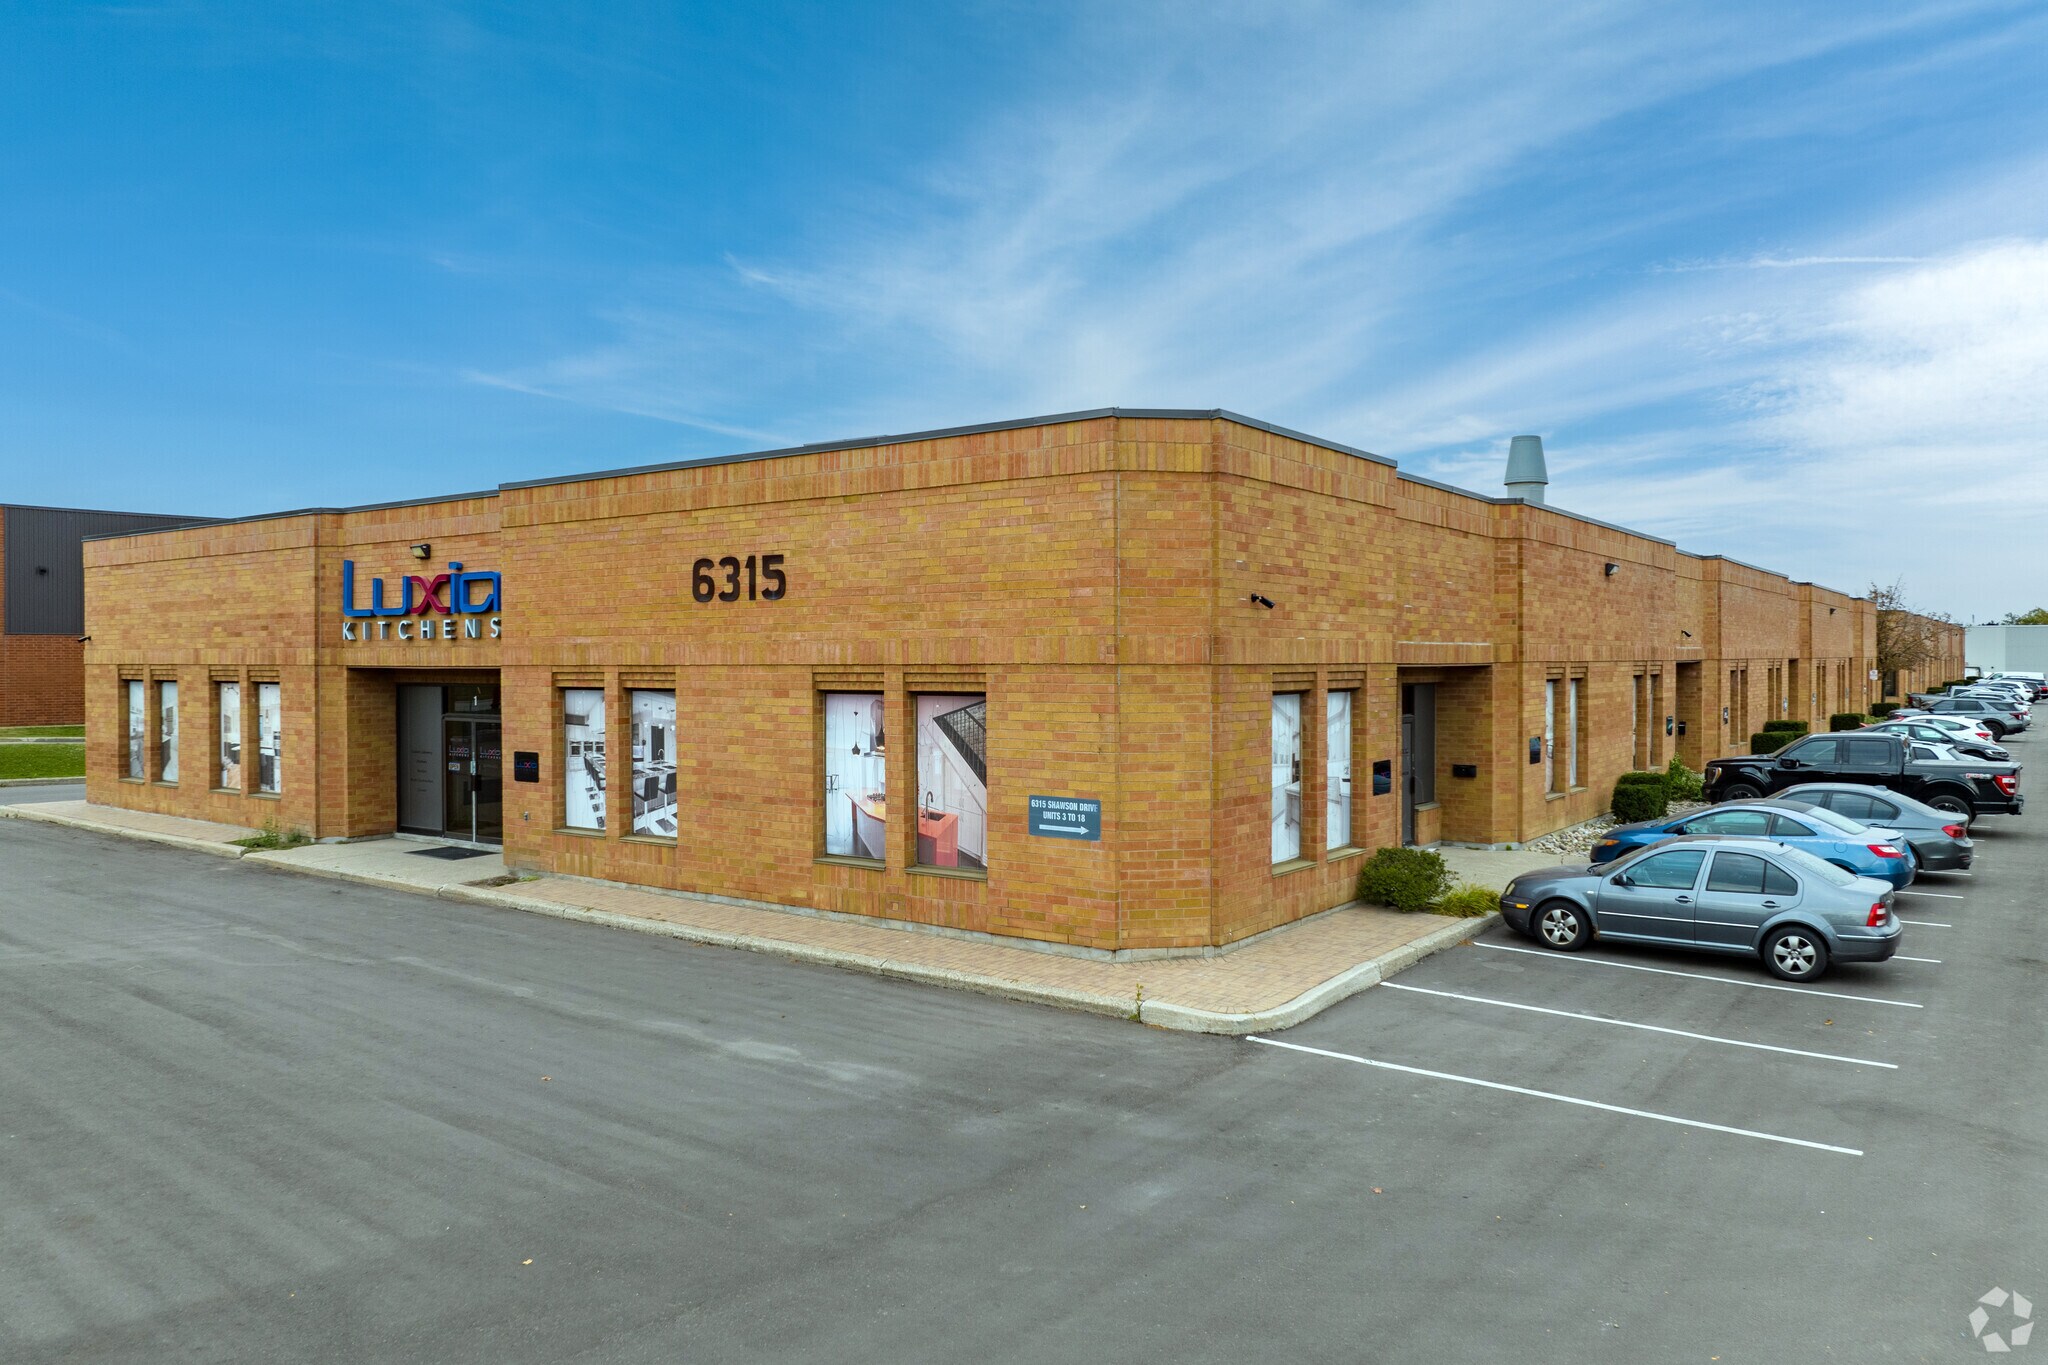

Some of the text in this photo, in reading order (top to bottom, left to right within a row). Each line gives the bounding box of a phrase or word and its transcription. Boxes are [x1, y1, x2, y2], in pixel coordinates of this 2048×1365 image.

[343, 560, 501, 616] Luxia
[692, 554, 787, 602] 6315
[342, 617, 501, 641] KITCHENS
[1031, 799, 1098, 812] 6315 SHAWSON DRIVE
[1043, 811, 1086, 822] UNITS 3 TO 18
